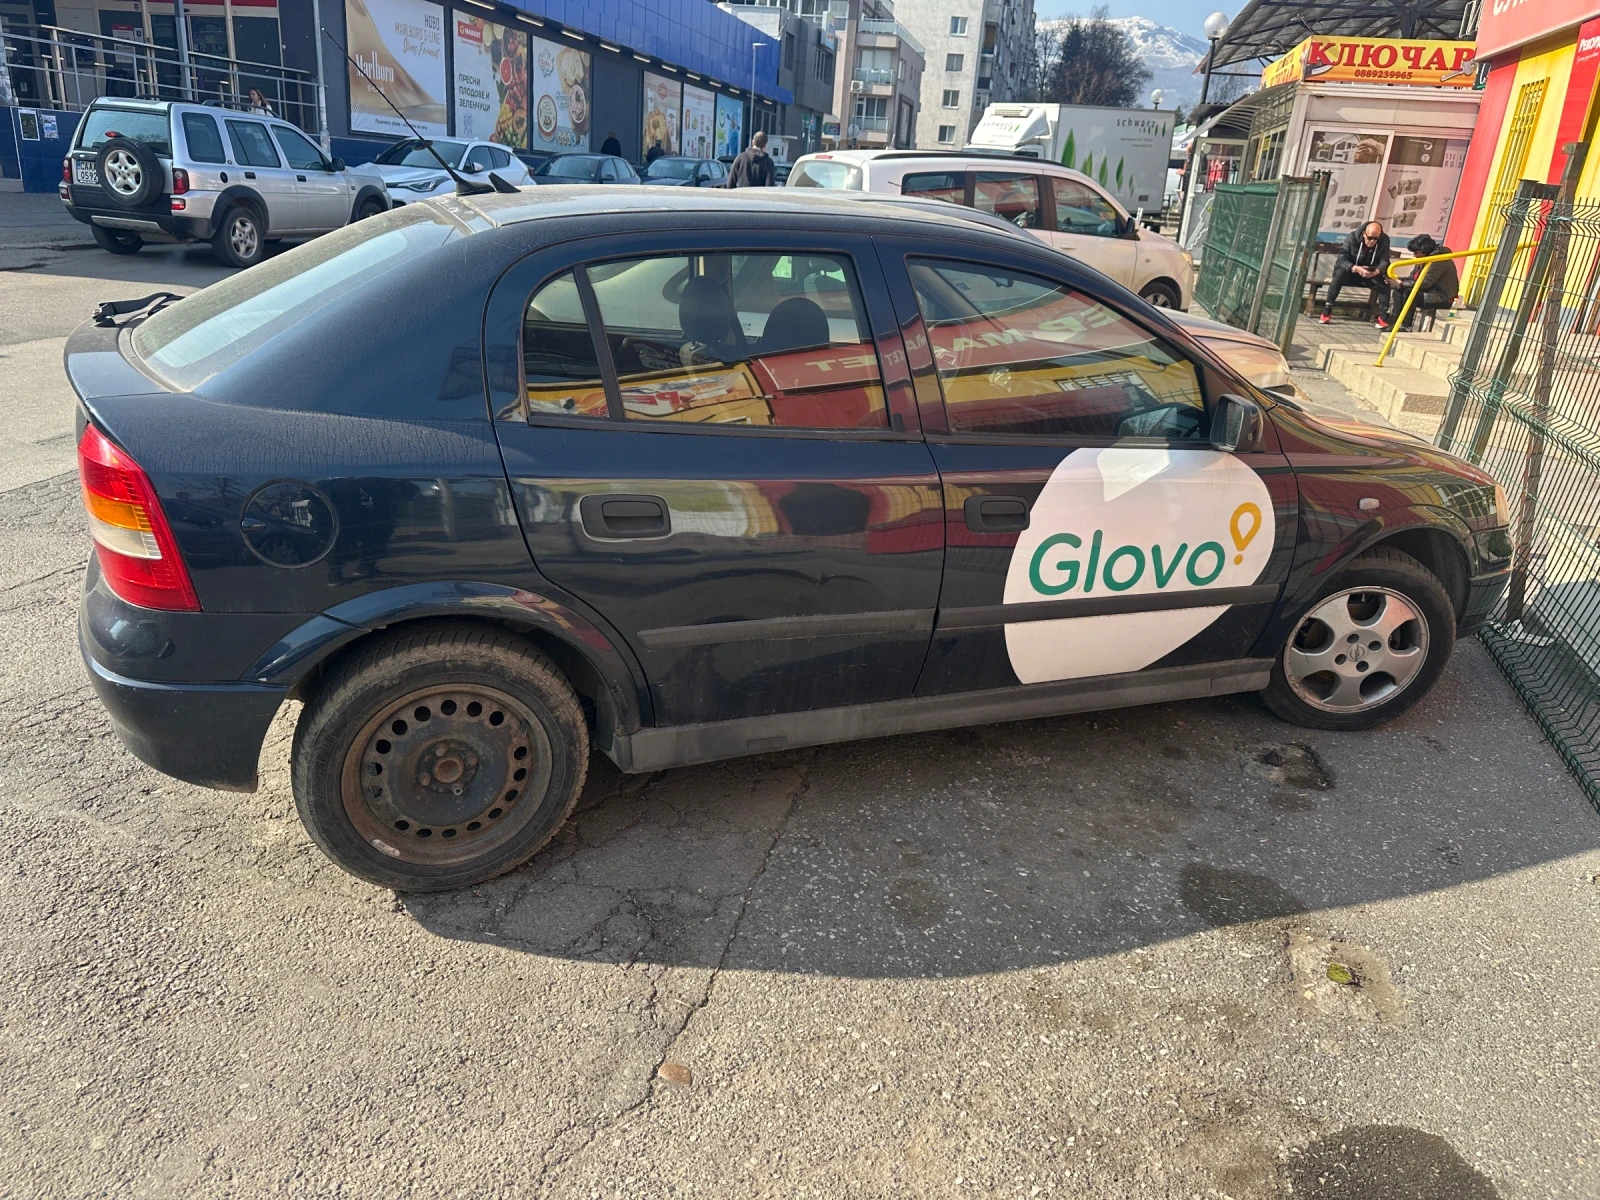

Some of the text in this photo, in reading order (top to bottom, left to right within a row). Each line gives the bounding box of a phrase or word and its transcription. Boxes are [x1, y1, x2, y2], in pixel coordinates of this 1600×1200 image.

[424, 13, 440, 31] НОВО
[394, 21, 423, 40] MARLBORO
[1308, 41, 1476, 71] КЛЮЧАР
[355, 50, 394, 83] Marlboro
[1354, 69, 1413, 80] 0889239965
[458, 73, 481, 86] ПРЕСНИ
[459, 86, 490, 100] ПЛОДОВЕ И
[459, 98, 490, 112] ЗЕЛЕНЧУЦИ
[1116, 116, 1156, 128] schwarz
[1029, 529, 1226, 596] Glovo
